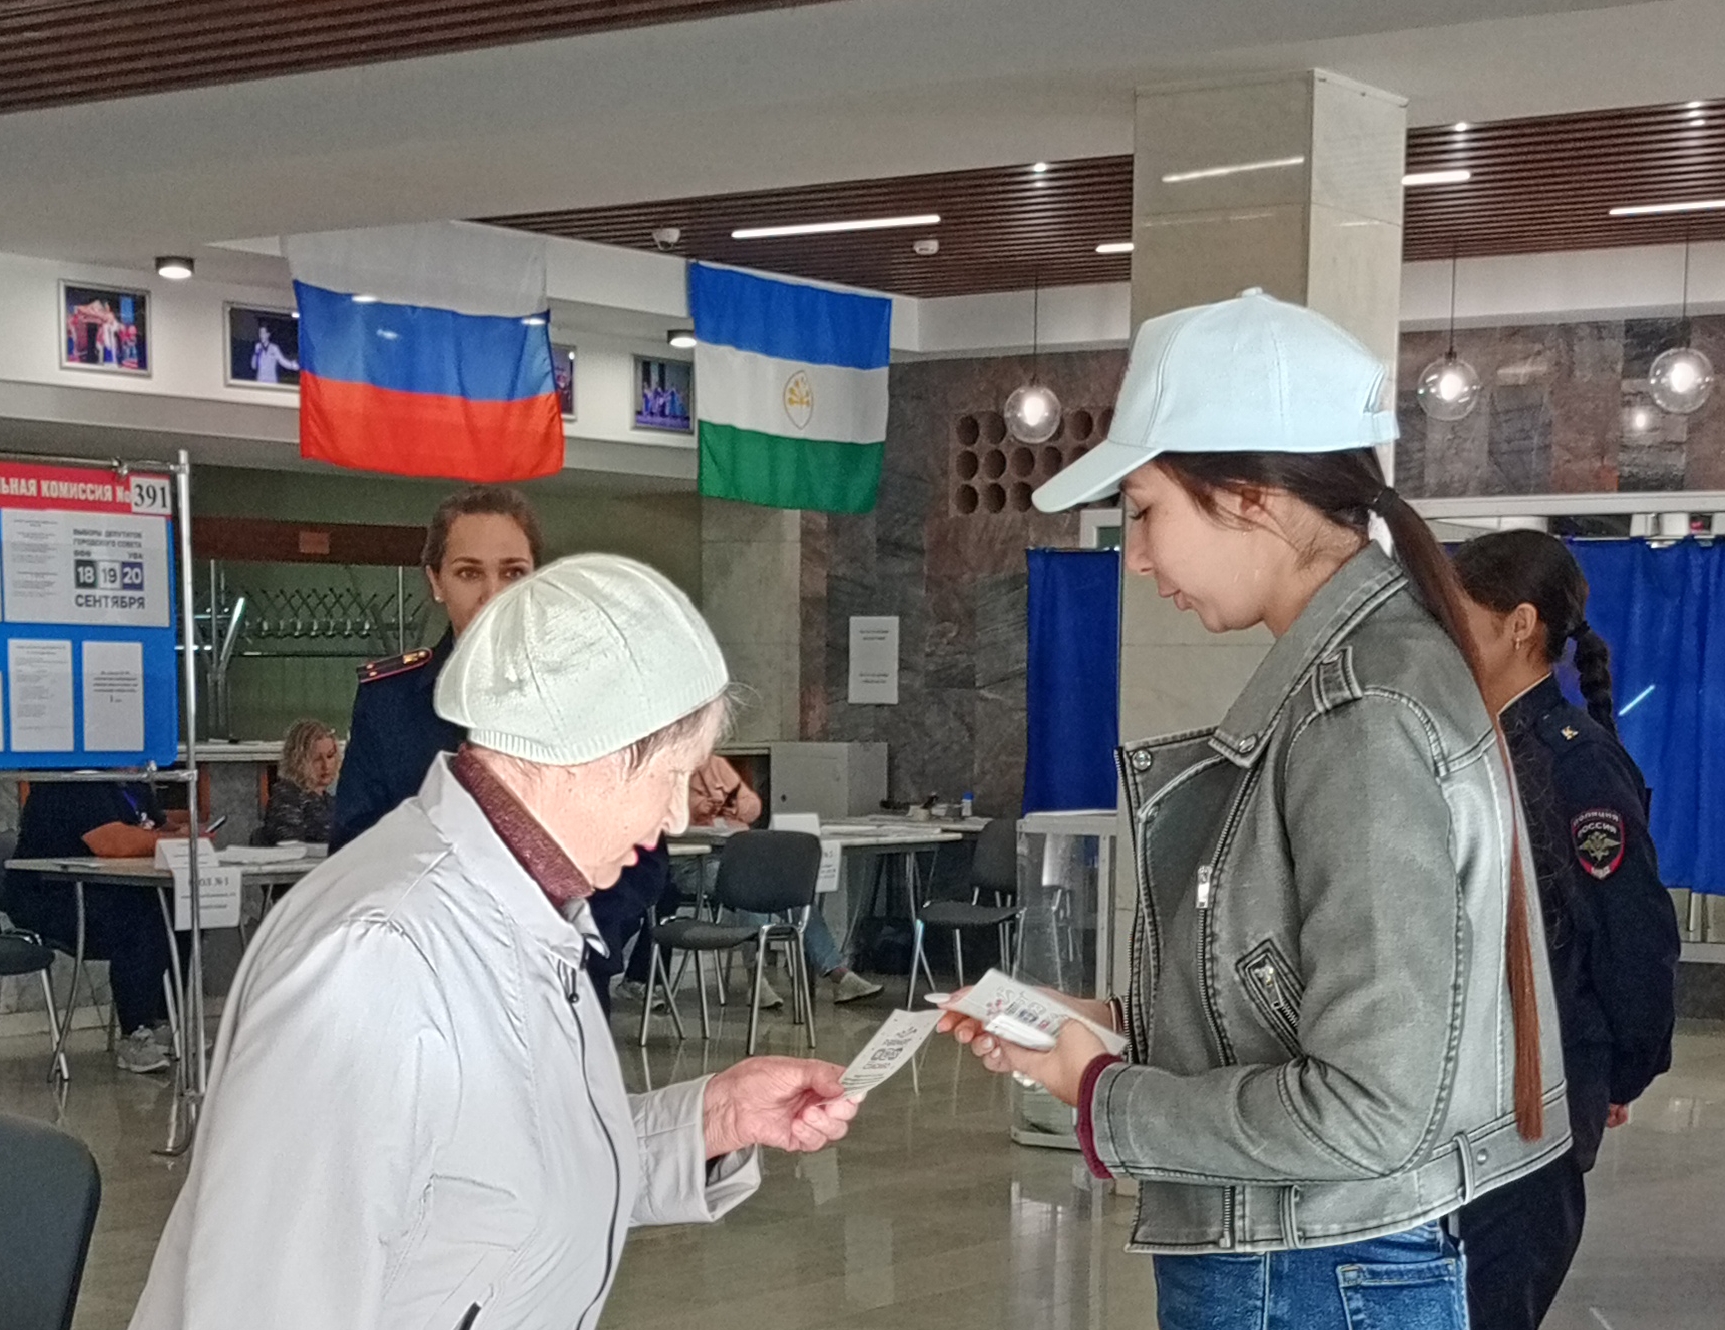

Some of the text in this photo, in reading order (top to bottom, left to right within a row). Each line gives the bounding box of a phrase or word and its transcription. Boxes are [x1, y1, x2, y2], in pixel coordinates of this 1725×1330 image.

[41, 479, 113, 502] КОМИССИЯ
[134, 483, 167, 508] 391
[73, 528, 142, 539] ВЫБОРЫ ДЕПУТАТОВ
[73, 538, 142, 548] ГОРОДСКОГО СОВЕТА
[77, 566, 95, 584] 18
[102, 567, 118, 584] 19
[122, 566, 142, 584] 20
[75, 594, 145, 609] СЕНТЯБРЯ
[1578, 822, 1617, 838] РОССИЯ
